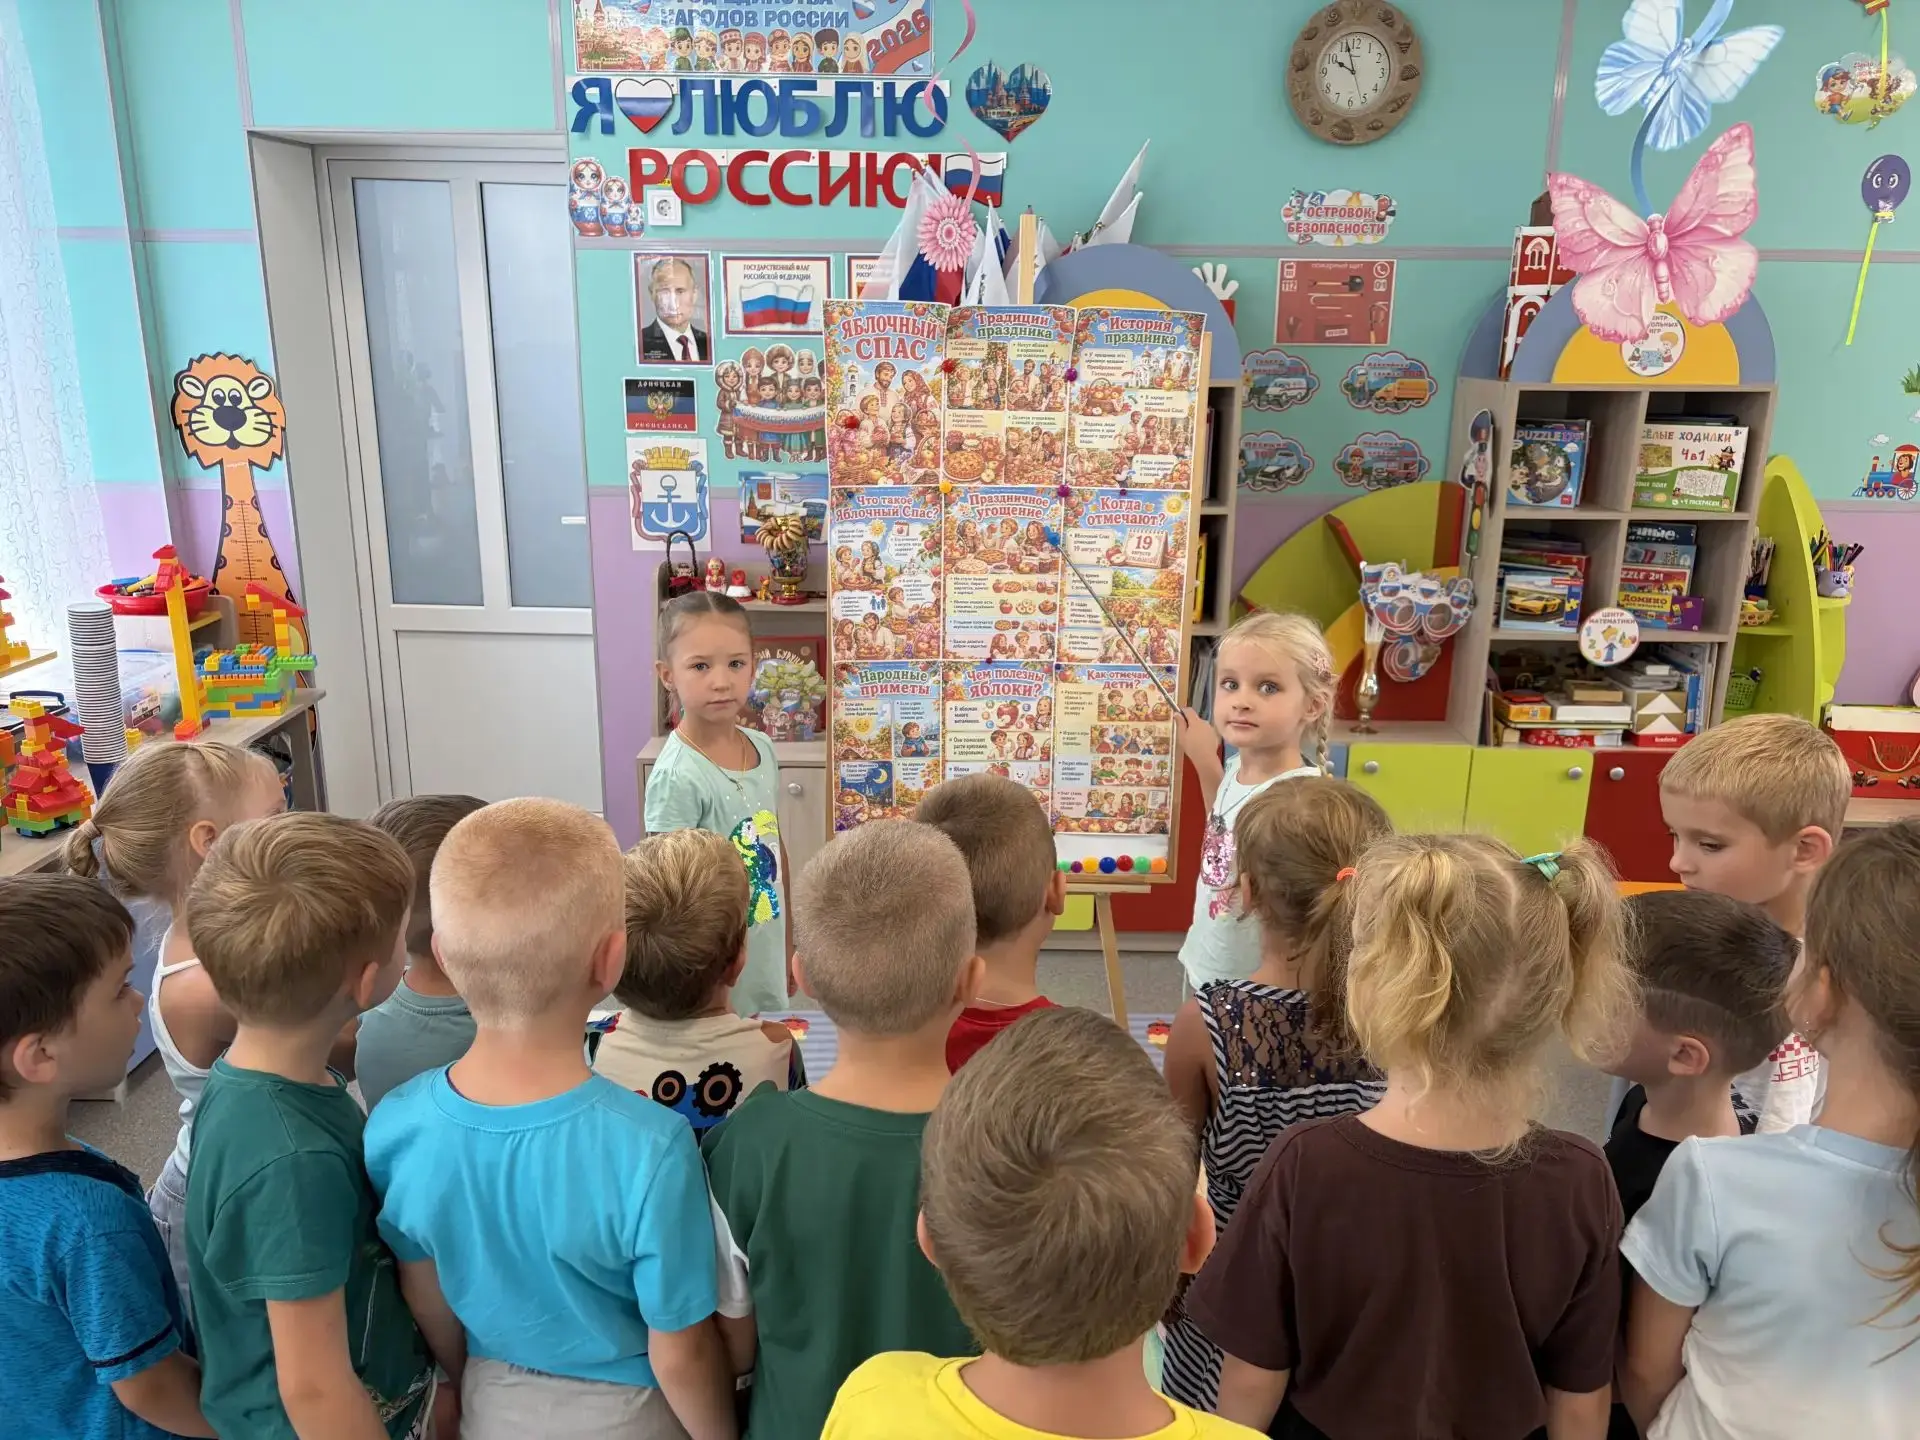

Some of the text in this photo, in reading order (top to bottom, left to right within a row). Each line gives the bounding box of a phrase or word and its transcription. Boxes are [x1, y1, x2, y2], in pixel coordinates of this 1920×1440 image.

[764, 10, 849, 28] РОССИИ
[866, 8, 932, 61] 2026
[571, 78, 948, 137] Я ЛЮБЛЮ
[1306, 207, 1372, 219] ОСТРОВОК
[1287, 222, 1385, 234] БЕЗОПАСНОСТИ
[976, 312, 1049, 326] Традиции
[1109, 317, 1173, 331] История
[842, 314, 938, 341] ЯБЛОЧНЫЙ
[977, 326, 1052, 339] праздника
[1104, 333, 1177, 345] праздника
[856, 336, 926, 361] СПАС
[1516, 430, 1561, 440] PUZZLE
[1642, 428, 1732, 443] ЁЛЫЕ ХОДИЛКИ
[857, 495, 913, 506] Что такое
[969, 493, 1048, 507] Праздничное
[1100, 497, 1142, 511] Когда
[835, 506, 939, 522] Яблочный Спас?
[976, 507, 1043, 520] угощение
[1087, 512, 1167, 526] отмечают?
[1135, 535, 1153, 550] 19
[1621, 570, 1646, 579] ZZLE
[1623, 594, 1668, 604] Домино
[859, 670, 928, 683] Народные
[967, 669, 1045, 683] Чем полезны
[1087, 670, 1152, 681] Как отмечаю
[860, 684, 930, 697] приметы
[970, 682, 1042, 697] яблоки?
[1102, 680, 1141, 690] дети?
